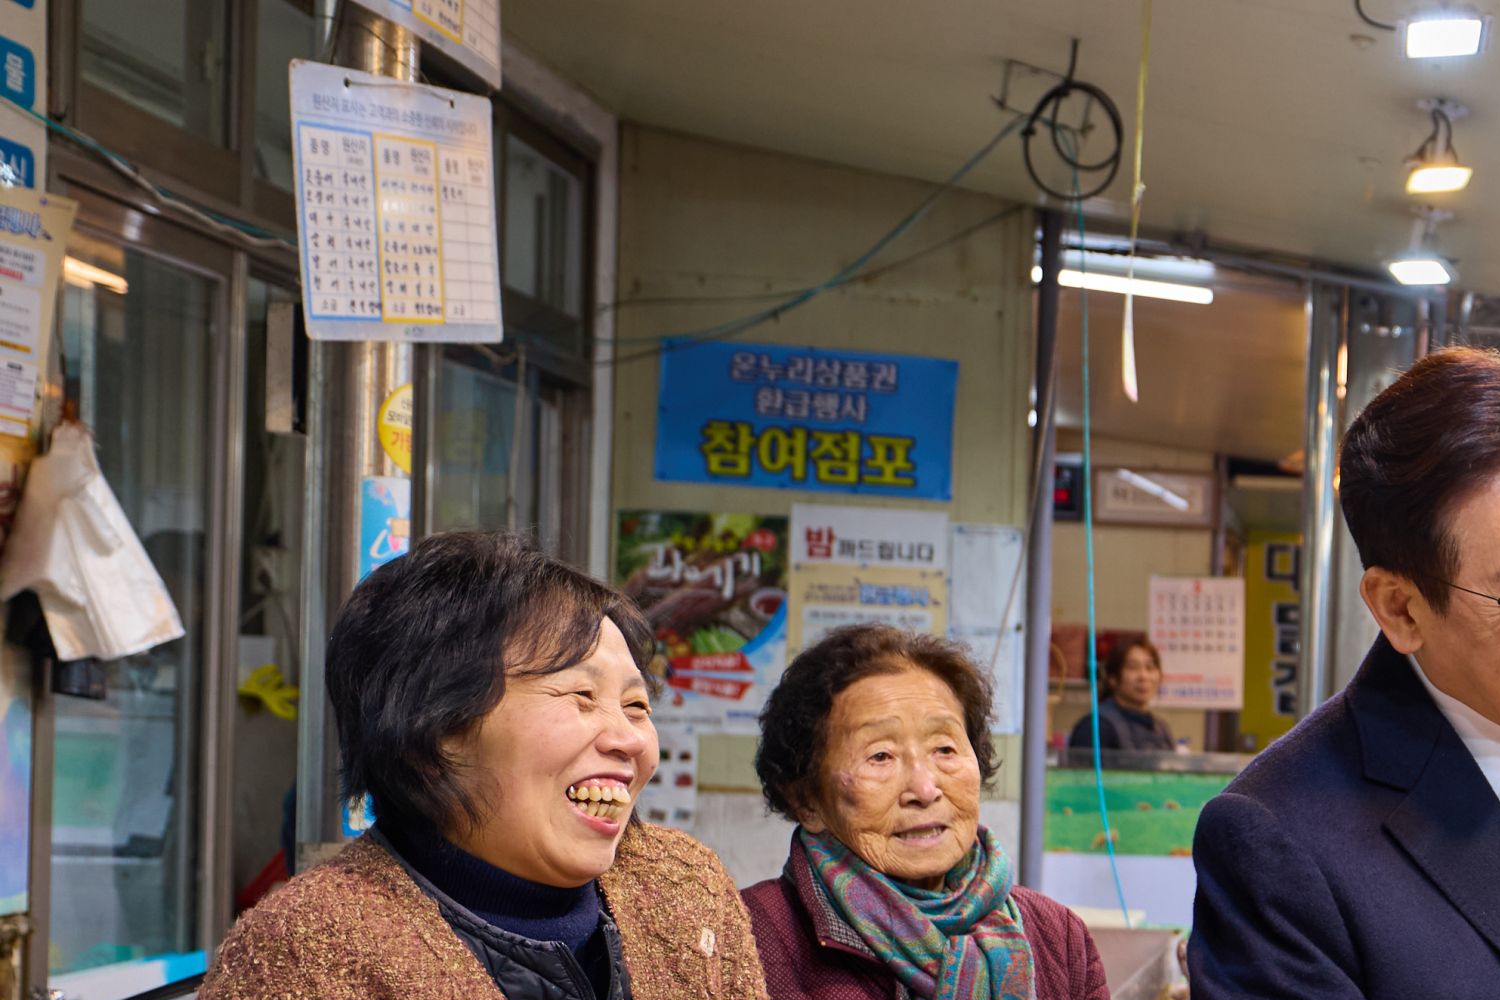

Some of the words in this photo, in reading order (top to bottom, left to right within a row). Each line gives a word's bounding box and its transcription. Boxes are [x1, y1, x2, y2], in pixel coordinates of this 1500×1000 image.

[730, 351, 898, 393] 온누리상품권
[756, 388, 868, 422] 환급행사
[701, 420, 916, 487] 참여점포
[647, 544, 762, 601] 과메기
